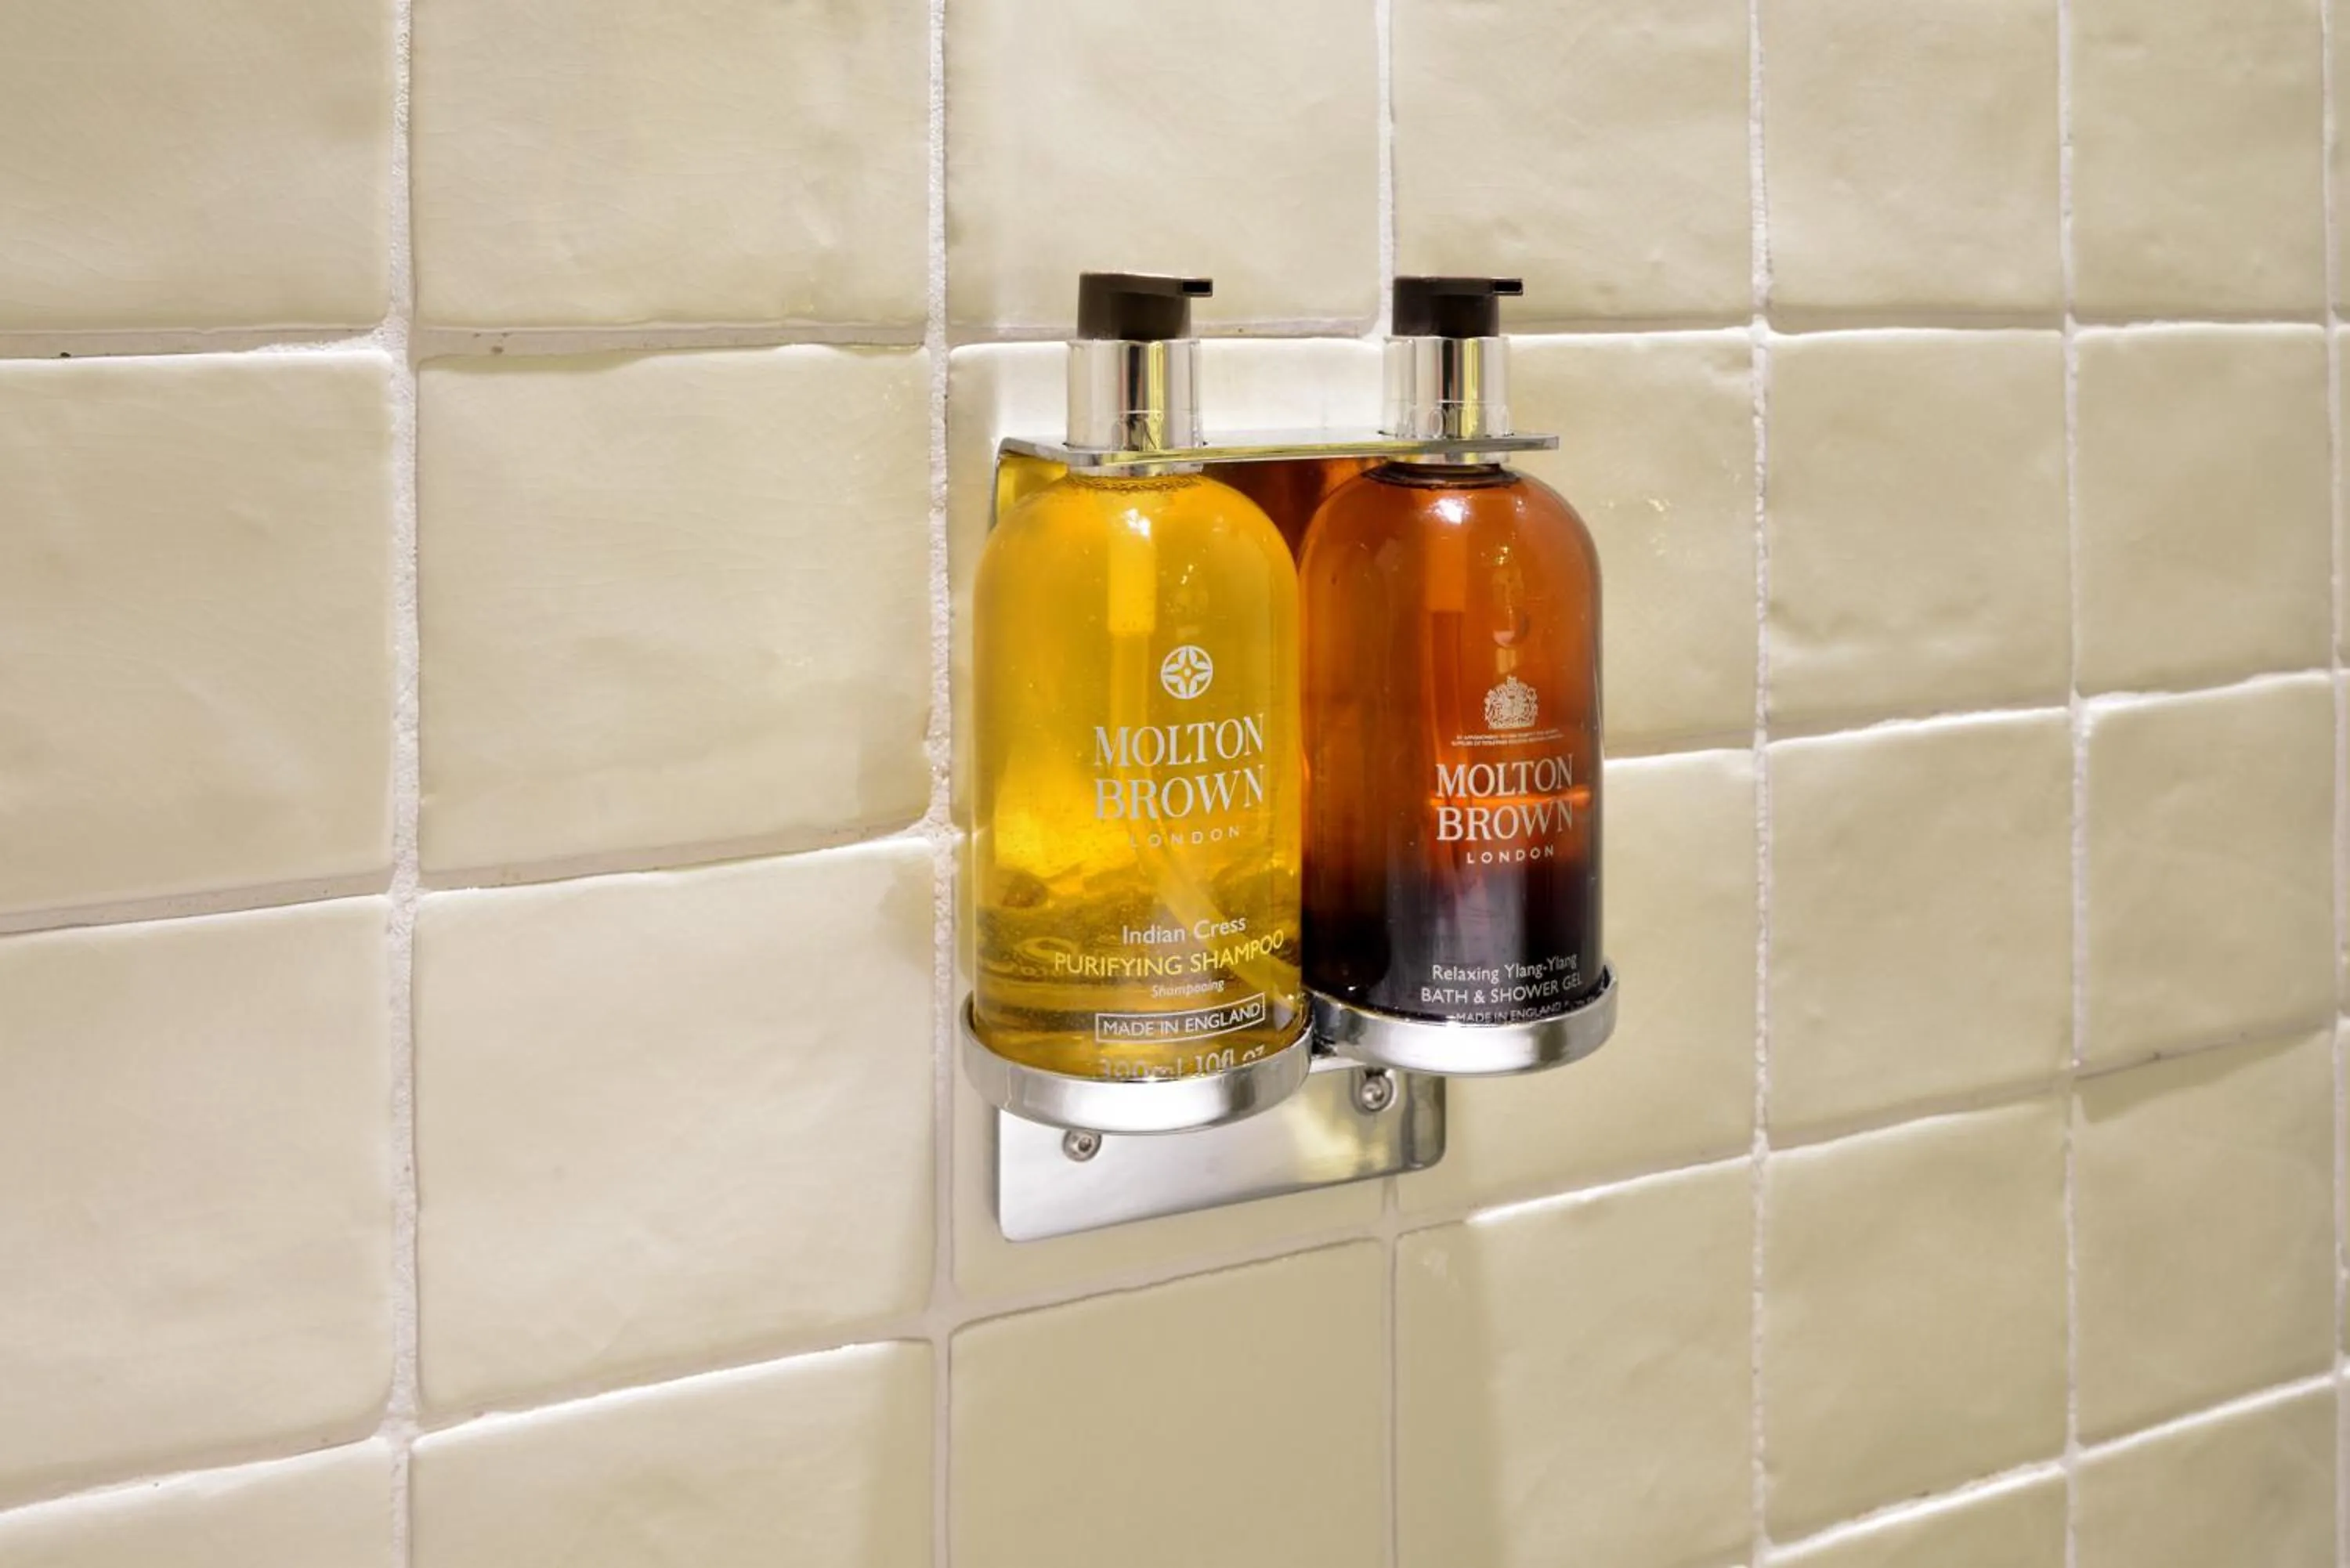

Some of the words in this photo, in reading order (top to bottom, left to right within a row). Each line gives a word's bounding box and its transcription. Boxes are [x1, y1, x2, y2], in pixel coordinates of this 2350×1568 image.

[1094, 714, 1264, 767] MOLTON
[1436, 753, 1573, 797] MOLTON
[1094, 764, 1264, 820] BROWN
[1130, 826, 1240, 848] LONDON
[1436, 800, 1573, 841] BROWN
[1466, 845, 1554, 864] LONDON
[1123, 925, 1185, 945] Indian
[1193, 917, 1246, 941] Cress
[1055, 952, 1182, 977] PURIFYING
[1190, 929, 1285, 973] SHAMPOO
[1432, 964, 1499, 985] Relaxing
[1504, 953, 1578, 979] Ylang-Ylang
[1421, 987, 1468, 1003] BATH
[1473, 989, 1485, 1003] &
[1491, 979, 1559, 1003] SHOWER
[1562, 973, 1583, 990] GEL
[1103, 1020, 1154, 1037] MADE
[1160, 1020, 1179, 1035] IN
[1184, 1002, 1261, 1033] ENGLAND
[1456, 1012, 1492, 1023] MADE
[1510, 1002, 1561, 1021] ENGLAND
